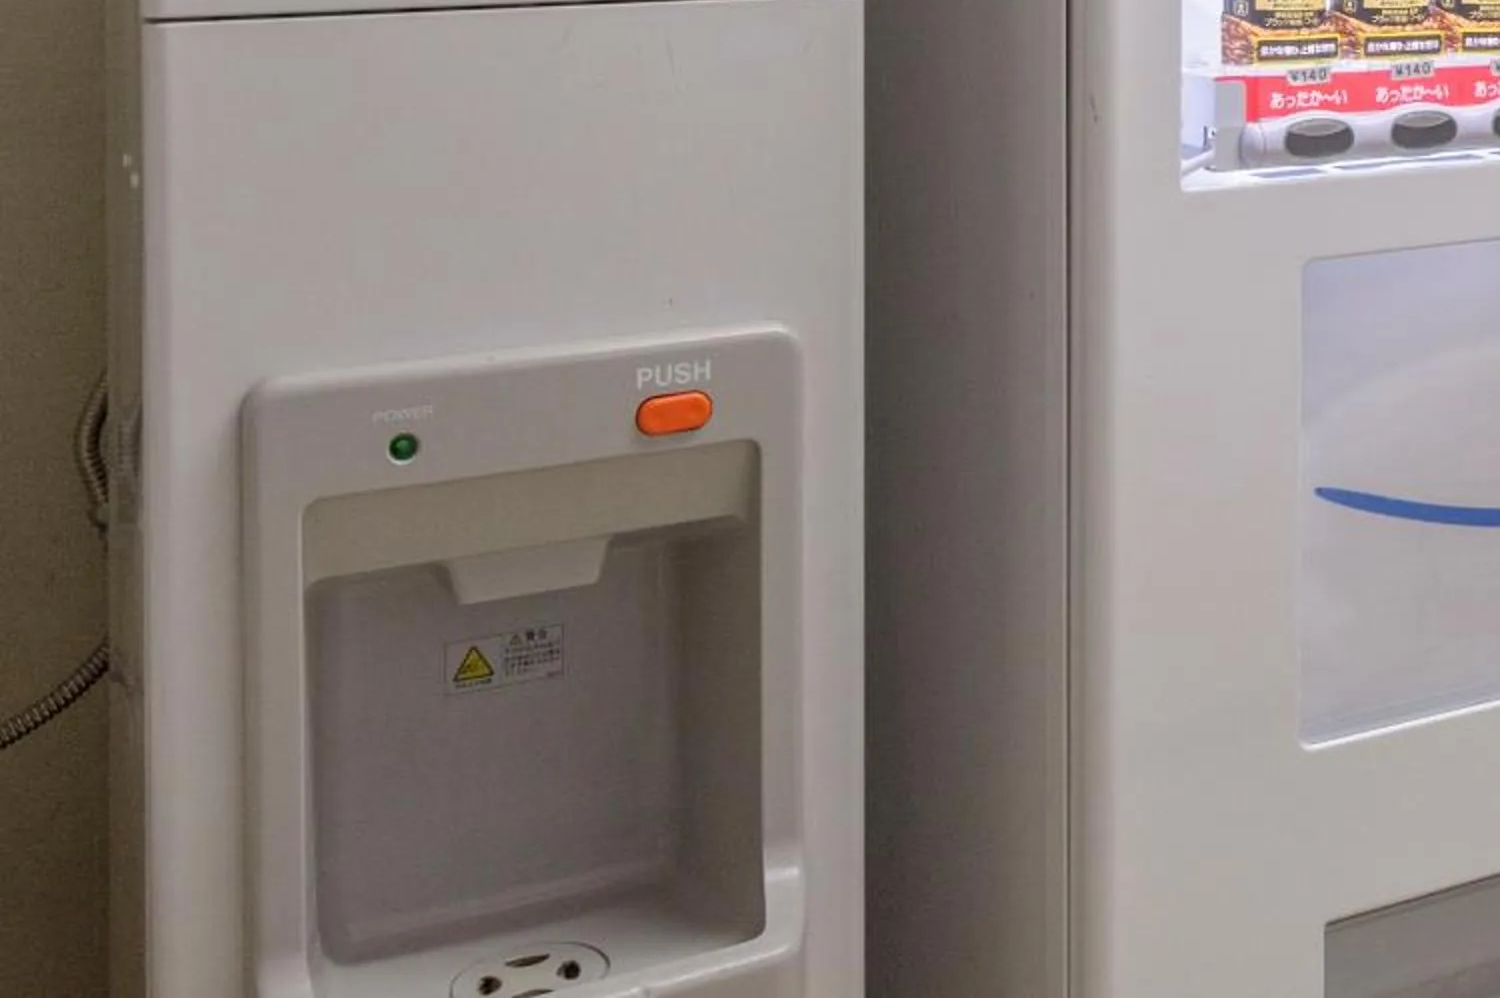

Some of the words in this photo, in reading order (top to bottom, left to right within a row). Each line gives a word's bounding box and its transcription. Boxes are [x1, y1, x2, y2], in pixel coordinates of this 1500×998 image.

[1291, 70, 1327, 83] ¥140
[1396, 64, 1431, 78] ¥140
[636, 360, 712, 389] PUSH
